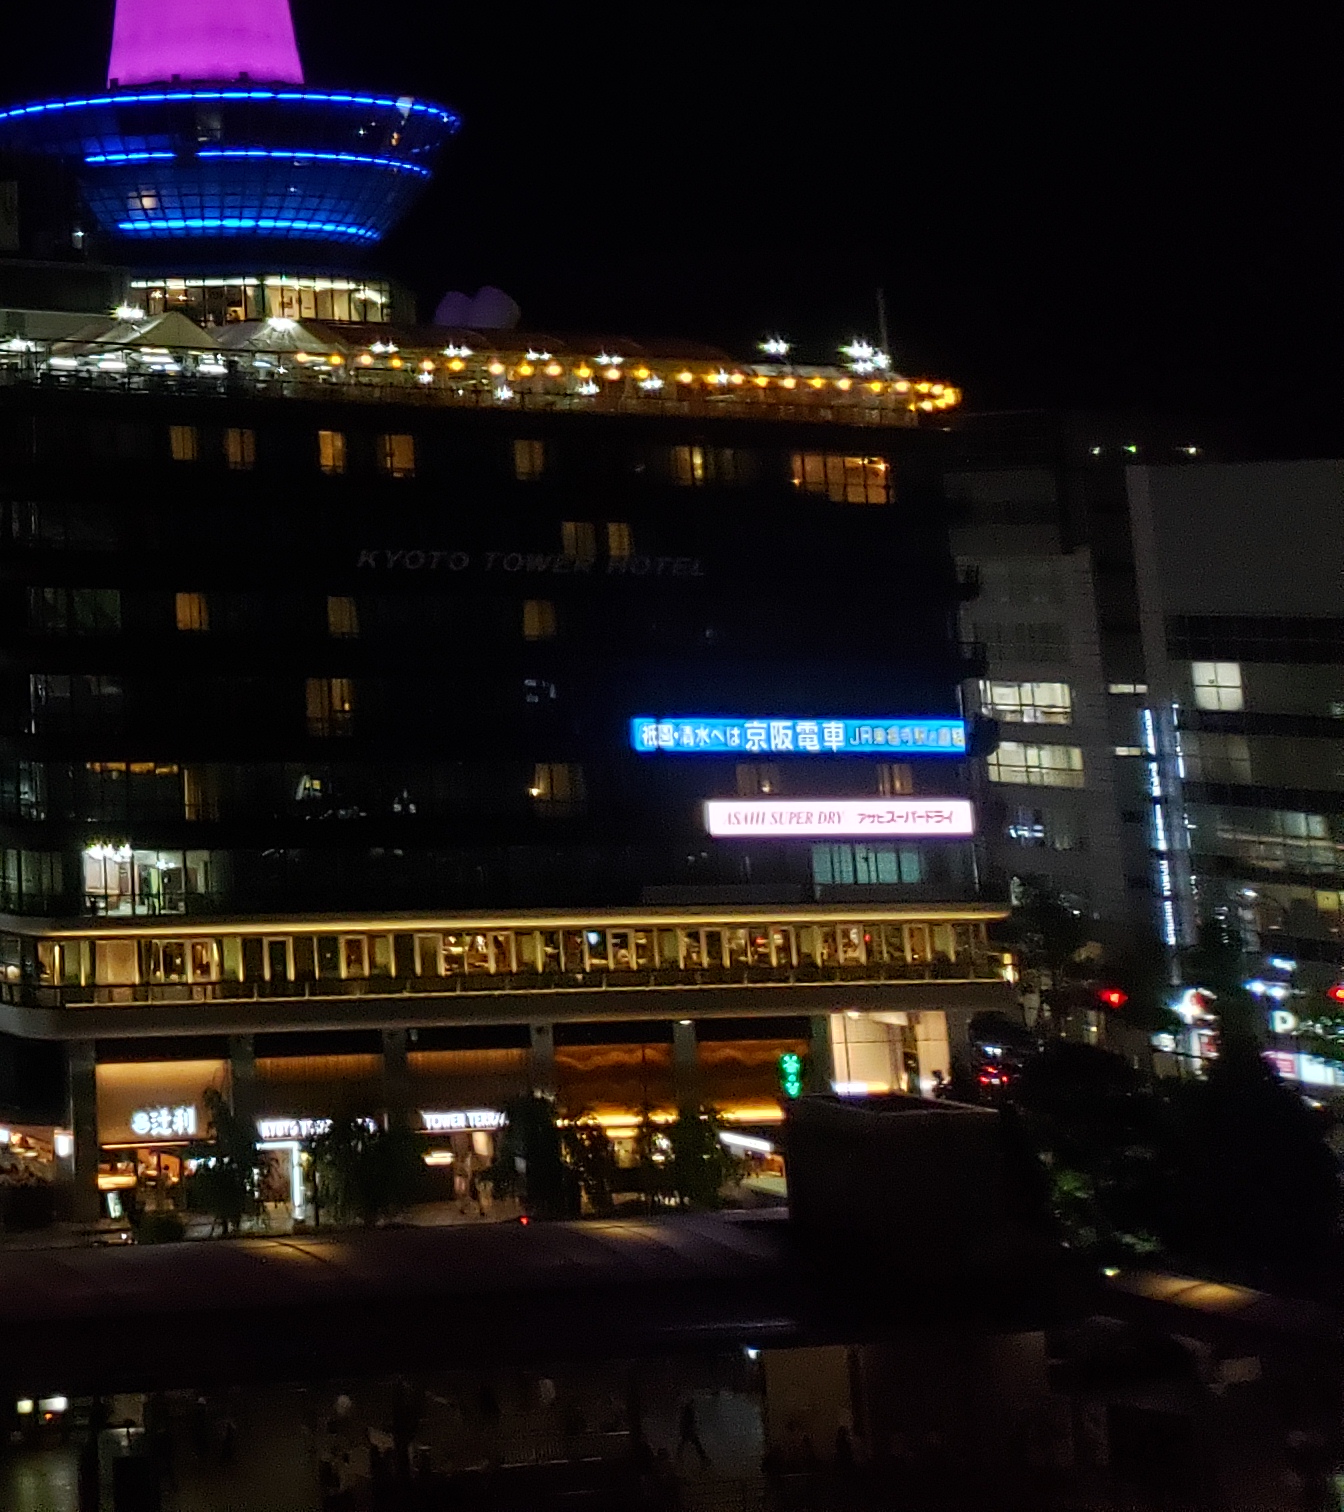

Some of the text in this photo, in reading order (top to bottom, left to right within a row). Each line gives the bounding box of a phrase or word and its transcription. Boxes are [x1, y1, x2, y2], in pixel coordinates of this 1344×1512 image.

[357, 549, 705, 576] KYOTO TOWER HOTEL
[744, 720, 844, 752] 京阪電車
[723, 810, 844, 825] ASAHI SUPER DRY
[857, 810, 954, 825] アサヒスーパードライ
[151, 1107, 197, 1136] 辻利
[261, 1120, 299, 1138] KYOTO
[422, 1112, 465, 1130] TOWER
